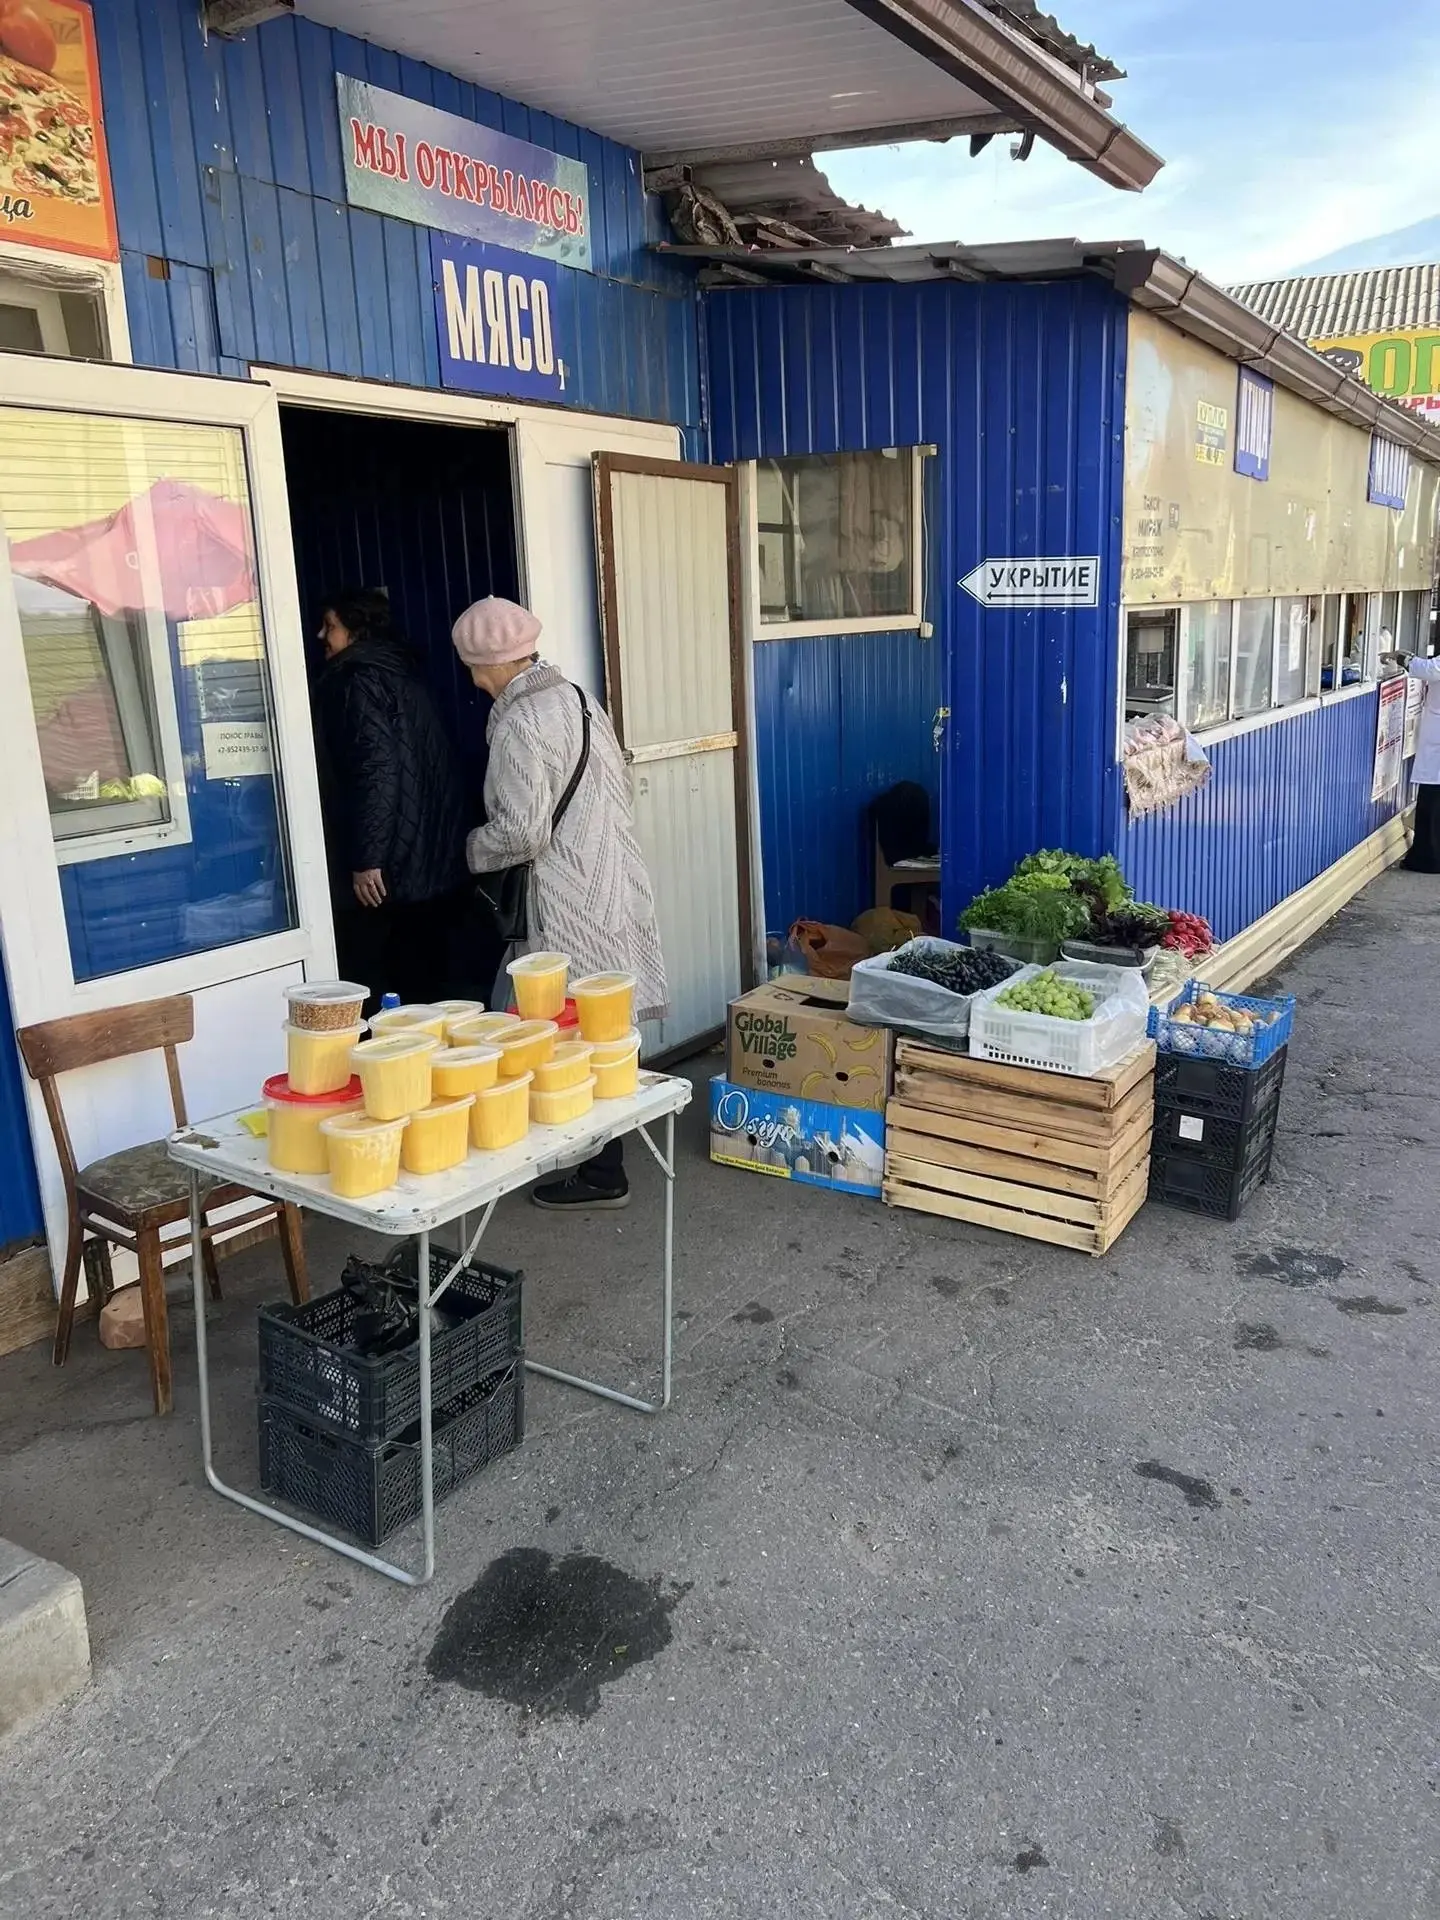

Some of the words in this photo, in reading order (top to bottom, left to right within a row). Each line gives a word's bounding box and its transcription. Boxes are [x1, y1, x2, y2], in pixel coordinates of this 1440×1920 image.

[351, 118, 409, 182] МЫ
[415, 141, 585, 236] ОТКРЫЛИСЬ!
[990, 566, 1090, 588] УКРЫТИЕ
[735, 1011, 789, 1035] Global
[740, 1032, 797, 1060] Village
[742, 1067, 778, 1079] Premium
[756, 1078, 791, 1089] bananas
